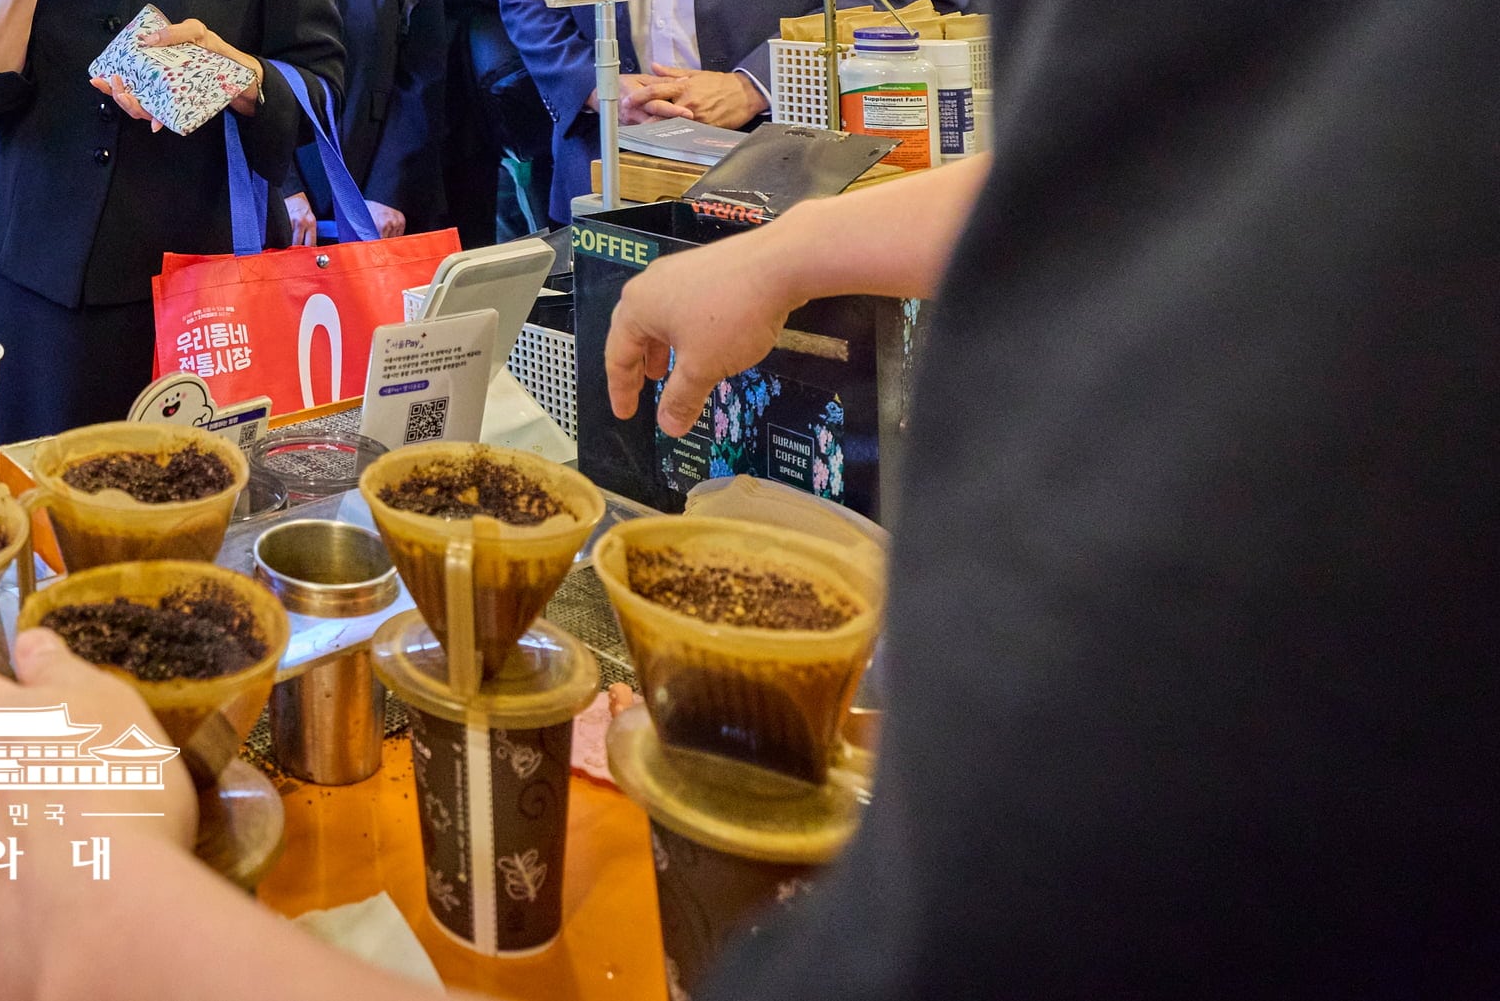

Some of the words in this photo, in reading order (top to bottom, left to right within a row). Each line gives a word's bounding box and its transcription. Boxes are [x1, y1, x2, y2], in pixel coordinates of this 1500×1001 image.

[571, 226, 649, 265] COFFEE
[176, 323, 249, 354] 우리동네
[772, 434, 811, 456] DURANNO
[775, 448, 808, 469] COFFEE
[779, 466, 805, 481] SPECIAL
